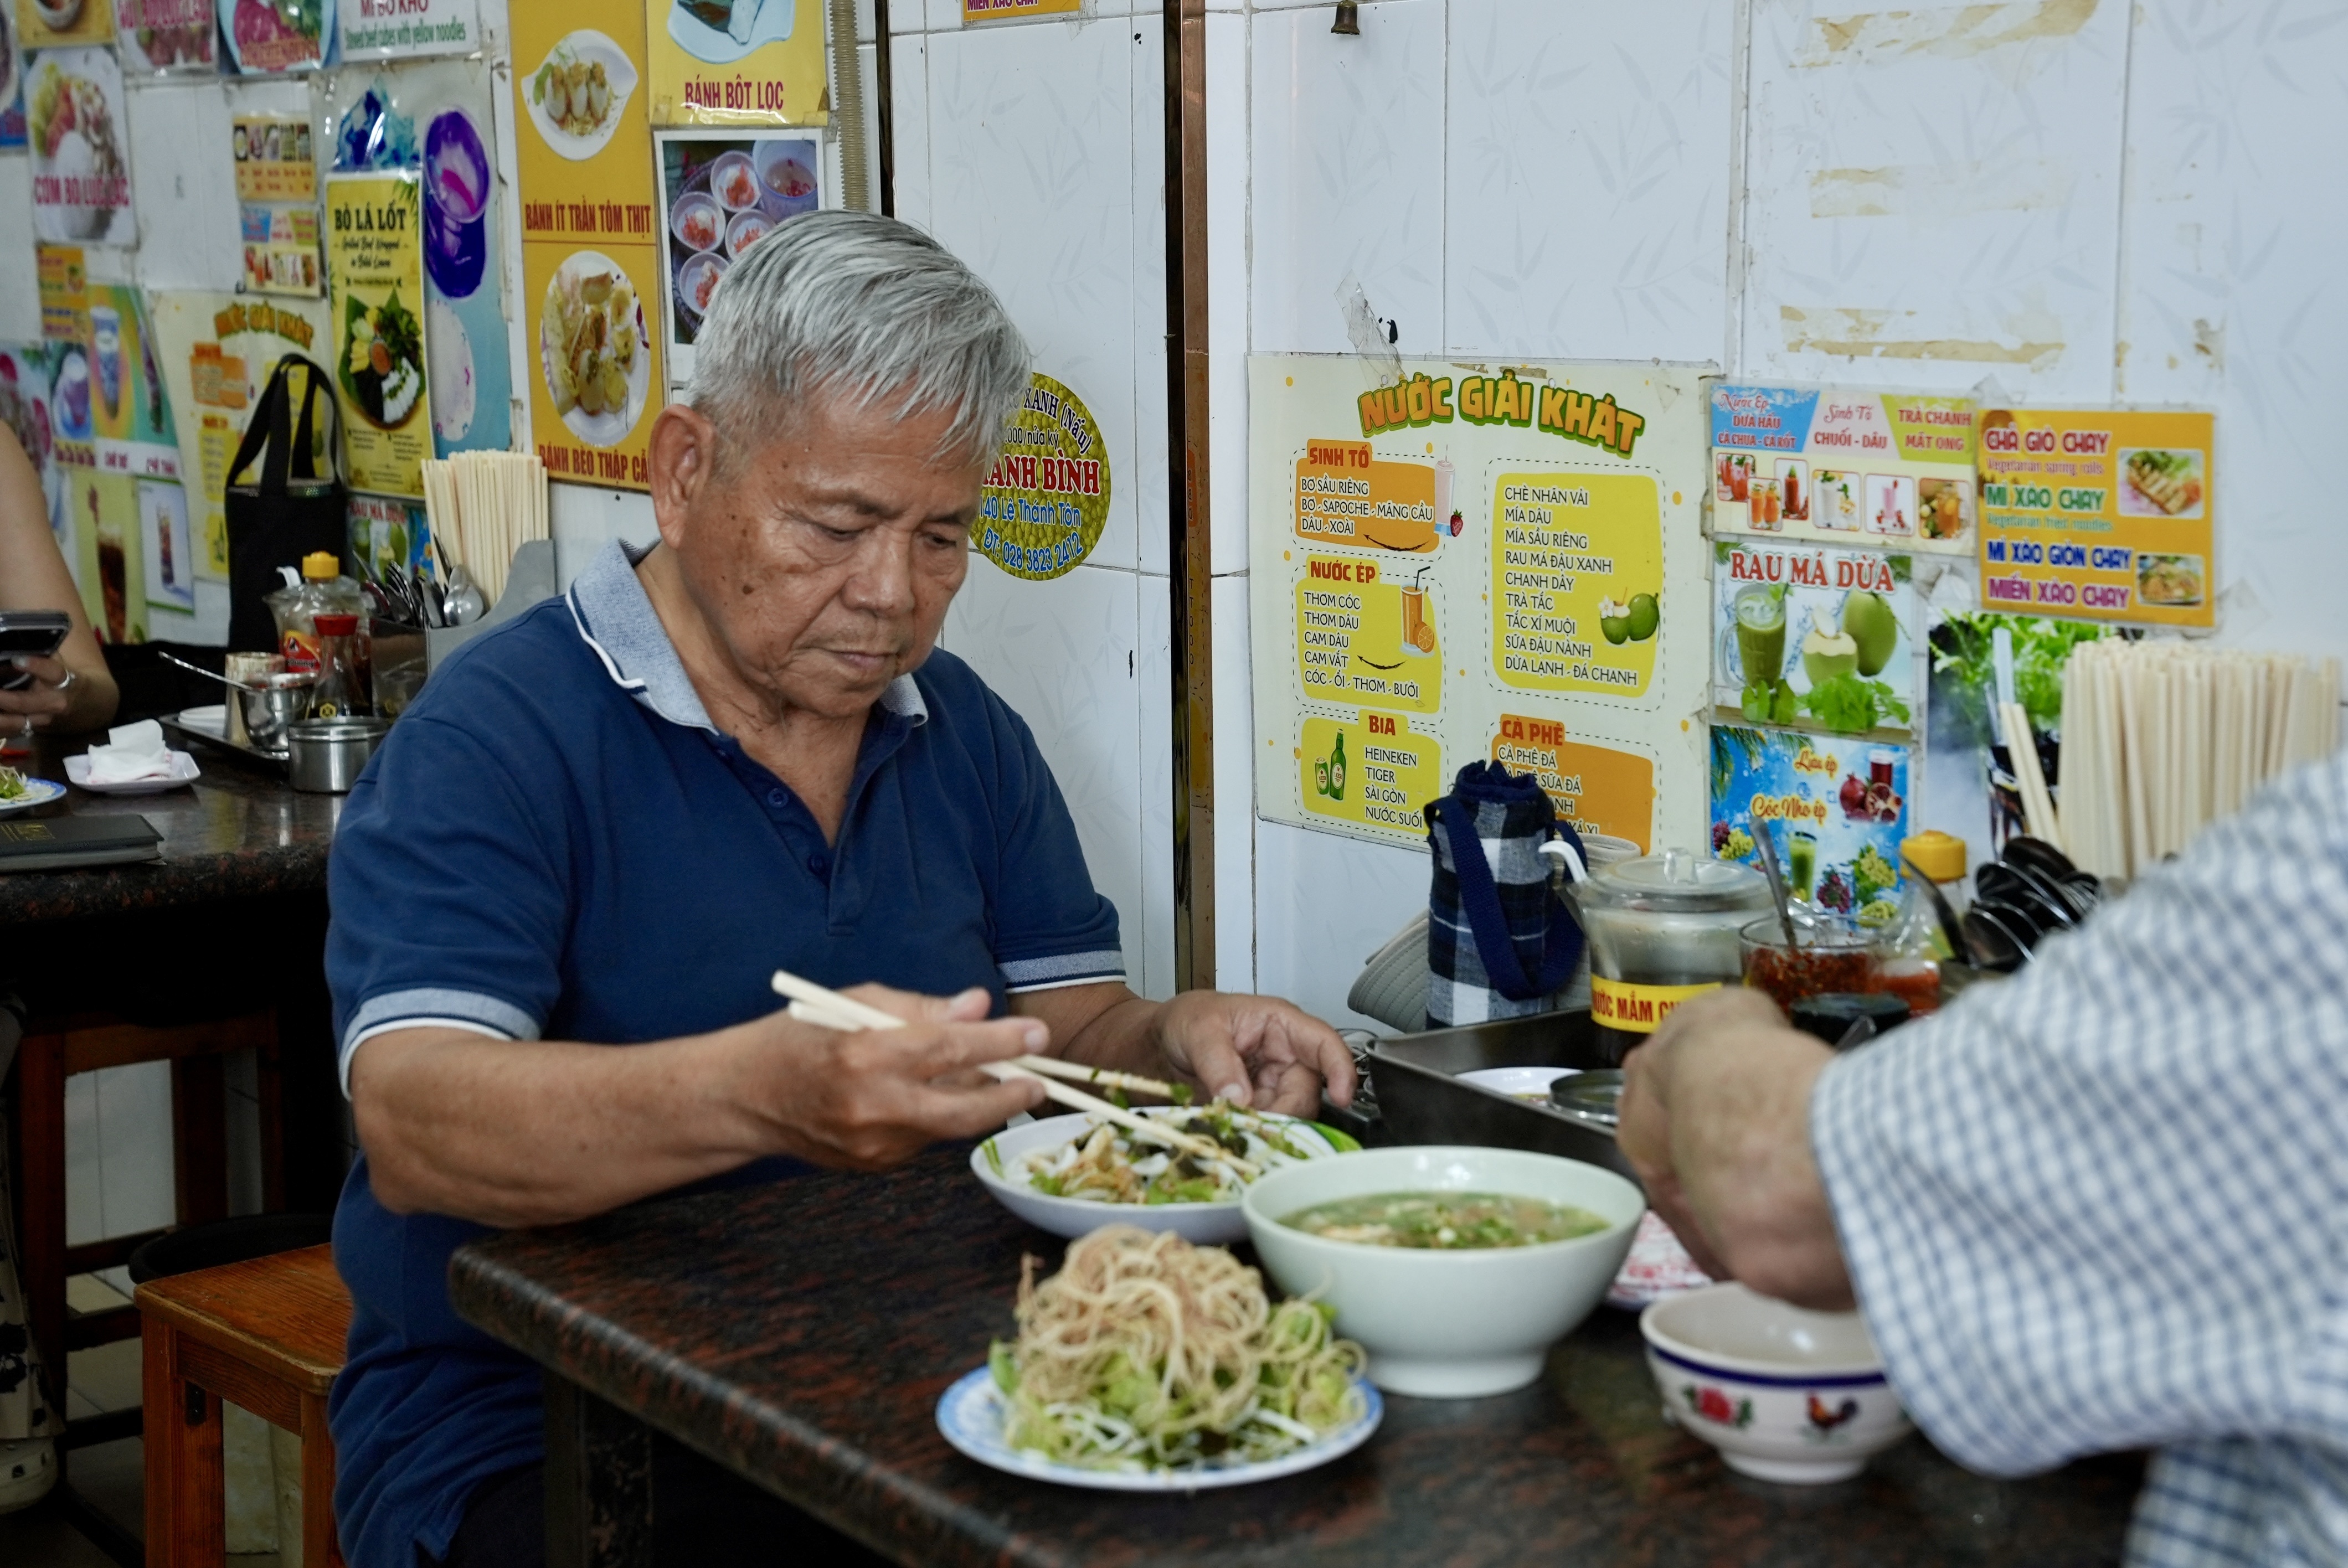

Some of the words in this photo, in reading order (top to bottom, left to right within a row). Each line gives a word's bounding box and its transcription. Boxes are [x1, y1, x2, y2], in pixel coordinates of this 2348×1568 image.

[436, 15, 466, 43] noodles
[684, 74, 720, 109] BÁNH
[335, 202, 351, 230] BÒ
[356, 202, 373, 230] LÁ
[525, 198, 553, 231] BÁNH
[556, 199, 565, 231] ÍT
[599, 199, 622, 233] TÔM
[626, 204, 651, 239] THỊT
[1024, 388, 1059, 419] XANH
[1061, 402, 1093, 455] (Nấu)
[1358, 372, 1453, 437] NƯỚC
[1459, 369, 1533, 427] GIẢI
[1538, 384, 1645, 459] KHÁT
[1898, 406, 1923, 423] TRÀ
[1925, 411, 1971, 426] CHANH
[1048, 427, 1059, 450] ký
[1732, 434, 1757, 446] CHUA
[1814, 427, 1851, 446] CHUỐI
[1862, 431, 1887, 449] DÂU
[1935, 436, 1964, 450] ONG
[2062, 432, 2110, 453] CHAY
[539, 441, 569, 472] BÁNH
[573, 445, 594, 476] BÈO
[598, 448, 627, 484] THẬP
[1310, 447, 1344, 467] SINH
[1348, 443, 1369, 468] TỐ
[1987, 458, 2041, 473] Vegetarian
[1043, 450, 1100, 495] BÌNH
[1301, 478, 1316, 492] BƠ
[1317, 474, 1336, 492] SẦU
[1338, 478, 1369, 495] RIÊNG
[1505, 484, 1528, 501] CHÈ
[1570, 488, 1589, 506] VẢI
[1301, 498, 1316, 512] BƠ
[1323, 499, 1369, 515] SAPOCHE
[1411, 501, 1433, 520] CẦU
[2059, 489, 2105, 512] CHAY
[1001, 497, 1015, 521] Lê
[1018, 498, 1055, 525] Thánh
[1058, 502, 1081, 527] Tôn
[1505, 506, 1526, 523] MÍA
[1528, 507, 1552, 524] DÂU
[1987, 513, 2041, 529] Vegetarian
[2046, 516, 2068, 529] fried
[2073, 515, 2113, 532] noodles
[1302, 518, 1322, 532] DÂU
[1330, 519, 1355, 534] XOÀI
[1505, 527, 1526, 544] MÍA
[1528, 526, 1549, 546] SẦU
[1553, 532, 1587, 549] RIÊNG
[1003, 541, 1023, 569] 028
[1026, 548, 1053, 572] 3823
[1055, 532, 1083, 567] 2412
[1505, 551, 1527, 565] RAU
[1530, 550, 1548, 567] MÁ
[1550, 554, 1574, 572] ĐẬU
[1577, 559, 1612, 574] XANH
[2092, 547, 2133, 569] CHAY
[1310, 559, 1351, 581] NƯỚC
[1356, 560, 1376, 584] ÉP
[1505, 572, 1548, 589] CHANH
[1552, 574, 1574, 591] DÂY
[1731, 551, 1783, 582] RAU
[1790, 550, 1829, 586] MÁ
[1837, 555, 1894, 591] DỪA
[1304, 592, 1336, 607] THƠM
[1338, 591, 1361, 610] CÓC
[1505, 591, 1528, 608] TRÀ
[1530, 591, 1554, 611] TẮC
[2083, 585, 2130, 608] CHAY
[1304, 612, 1336, 627] THƠM
[1339, 614, 1359, 630] DÂU
[1505, 610, 1528, 630] TẮC
[1531, 613, 1542, 630] XÍ
[1544, 620, 1576, 638] MUỘI
[1304, 632, 1326, 646] CAM
[1329, 632, 1349, 648] DÂU
[1505, 634, 1527, 651] SỮA
[1529, 636, 1553, 657] ĐẬU
[1556, 639, 1592, 658] NÀNH
[1305, 651, 1327, 665] CAM
[1329, 650, 1348, 668] VẮT
[1505, 654, 1528, 672] DỪA
[1531, 660, 1564, 678] LẠNH
[1573, 662, 1589, 680] ĐÁ
[1591, 668, 1638, 686] CHANH
[1305, 669, 1327, 684] CÓC
[1334, 669, 1345, 687] ỔI
[1353, 677, 1386, 693] THƠM
[1394, 682, 1419, 698] BƯỞI
[1368, 715, 1396, 736] BIA
[1502, 718, 1524, 740] CÀ
[1529, 723, 1563, 746] PHÊ
[1366, 747, 1417, 766] HEINEKEN
[1499, 745, 1514, 761] CÀ
[1516, 749, 1538, 765] PHÊ
[1541, 752, 1557, 768] ĐÁ
[1365, 767, 1395, 783] TIGER
[1541, 772, 1563, 791] SỮA
[1565, 776, 1581, 794] ĐÁ
[1366, 783, 1379, 800] SÀI
[1382, 789, 1405, 804] GÒN
[1366, 806, 1396, 823] NƯỚC
[1398, 811, 1423, 828] SUỐI
[1781, 797, 1811, 819] Nho
[1617, 990, 1654, 1023] MẮM
